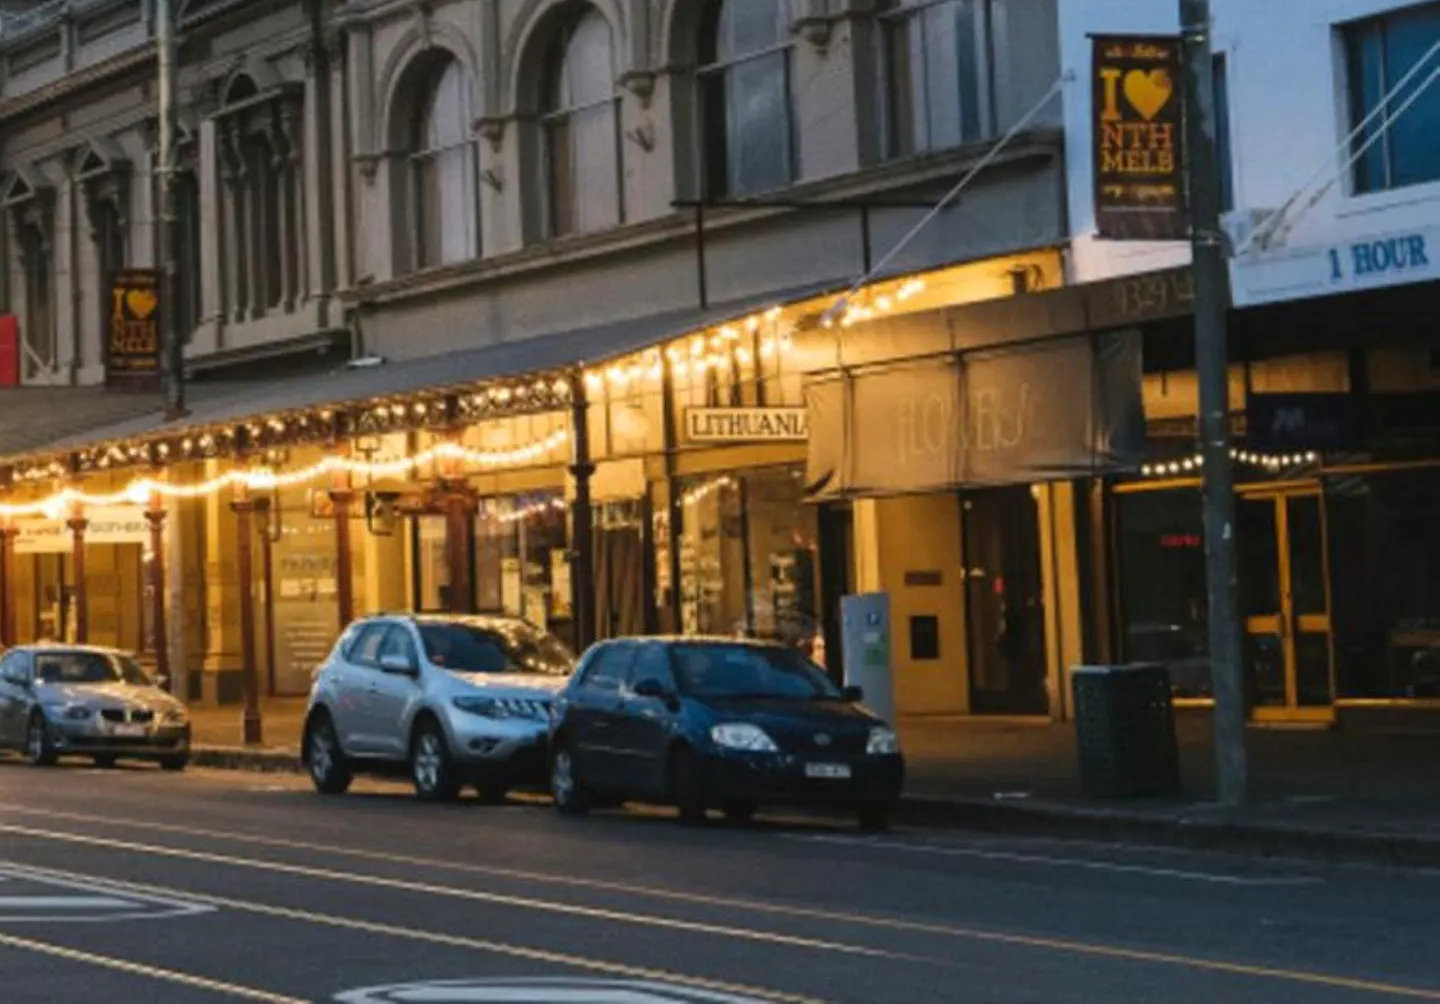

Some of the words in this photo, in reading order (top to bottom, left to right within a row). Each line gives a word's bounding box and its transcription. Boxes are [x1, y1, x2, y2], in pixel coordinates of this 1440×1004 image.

[1100, 67, 1122, 121] I
[1101, 122, 1174, 149] NTH
[1101, 149, 1175, 173] MELB
[1352, 233, 1429, 275] HOUR
